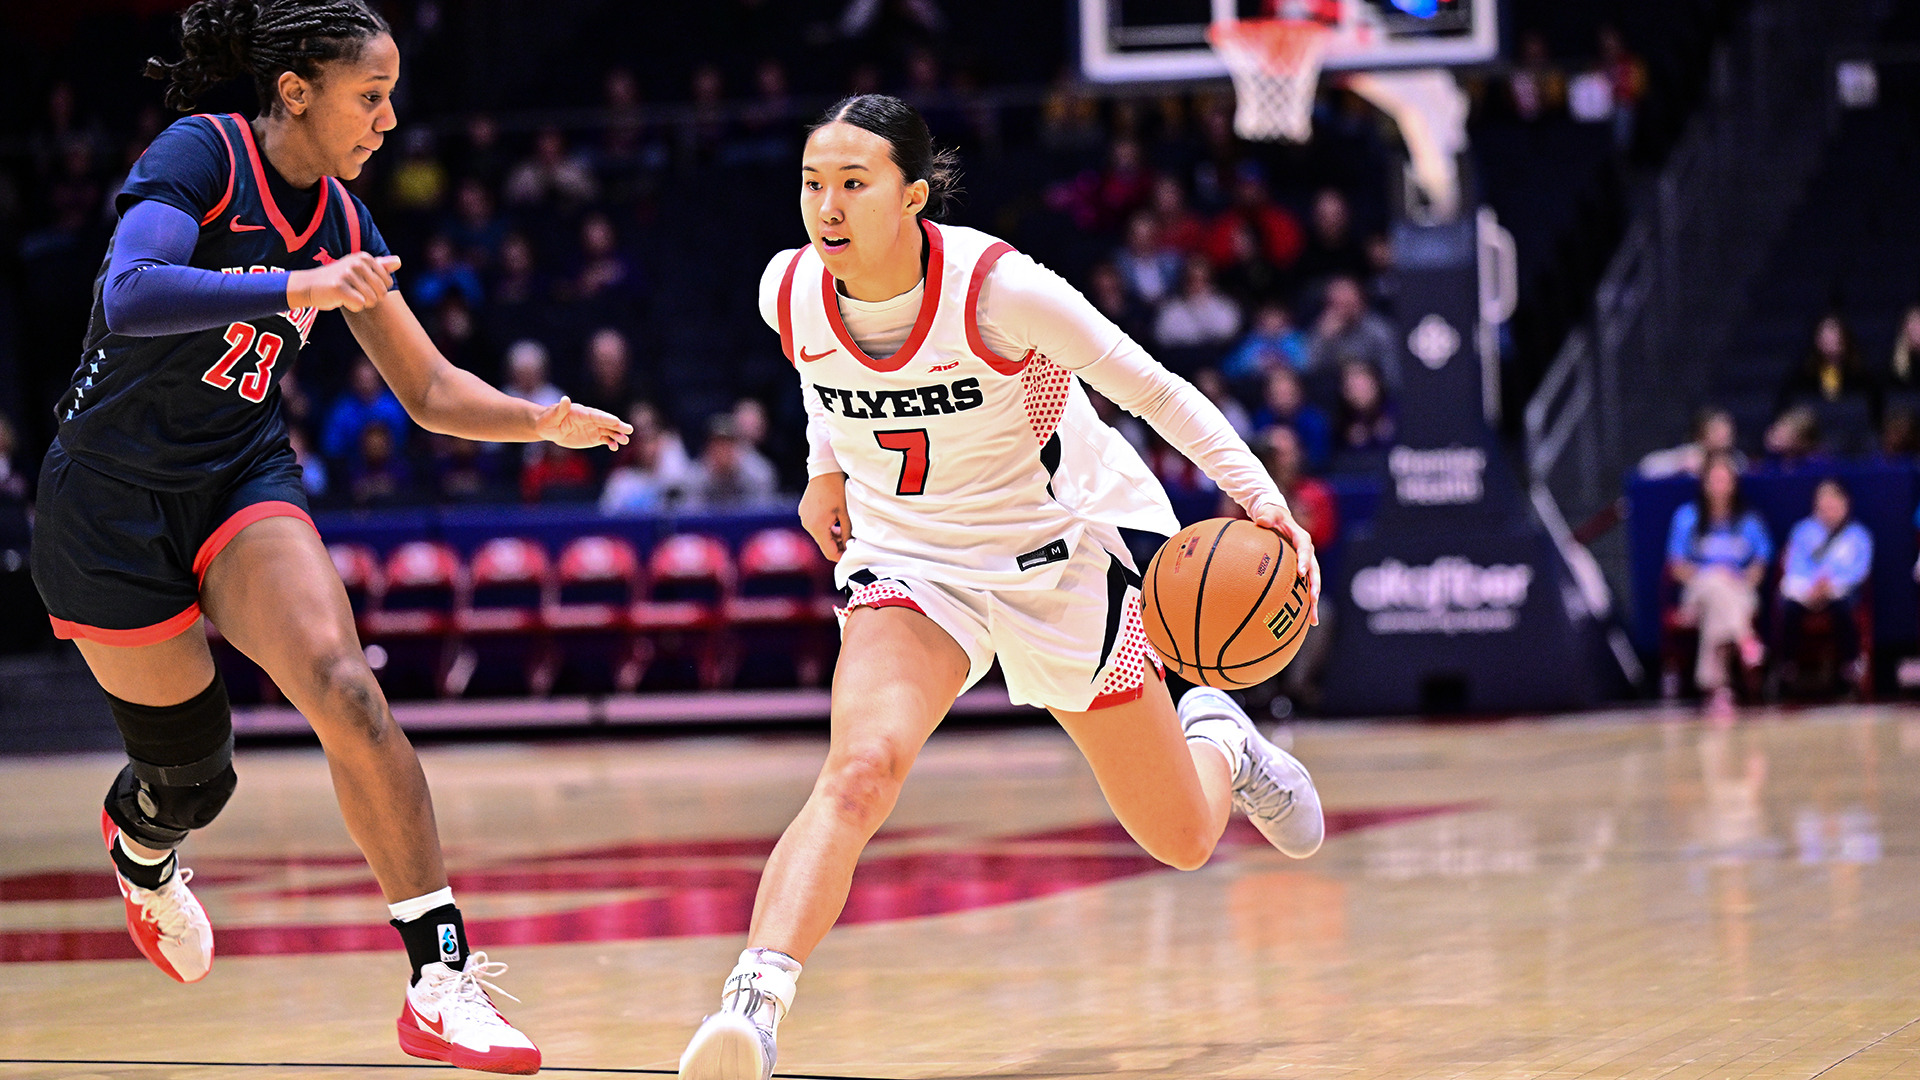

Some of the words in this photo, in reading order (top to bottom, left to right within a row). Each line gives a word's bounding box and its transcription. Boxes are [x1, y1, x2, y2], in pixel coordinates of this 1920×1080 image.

[201, 320, 284, 404] 23
[812, 376, 984, 420] FLYERS
[872, 427, 931, 496] 7
[1051, 545, 1062, 556] M
